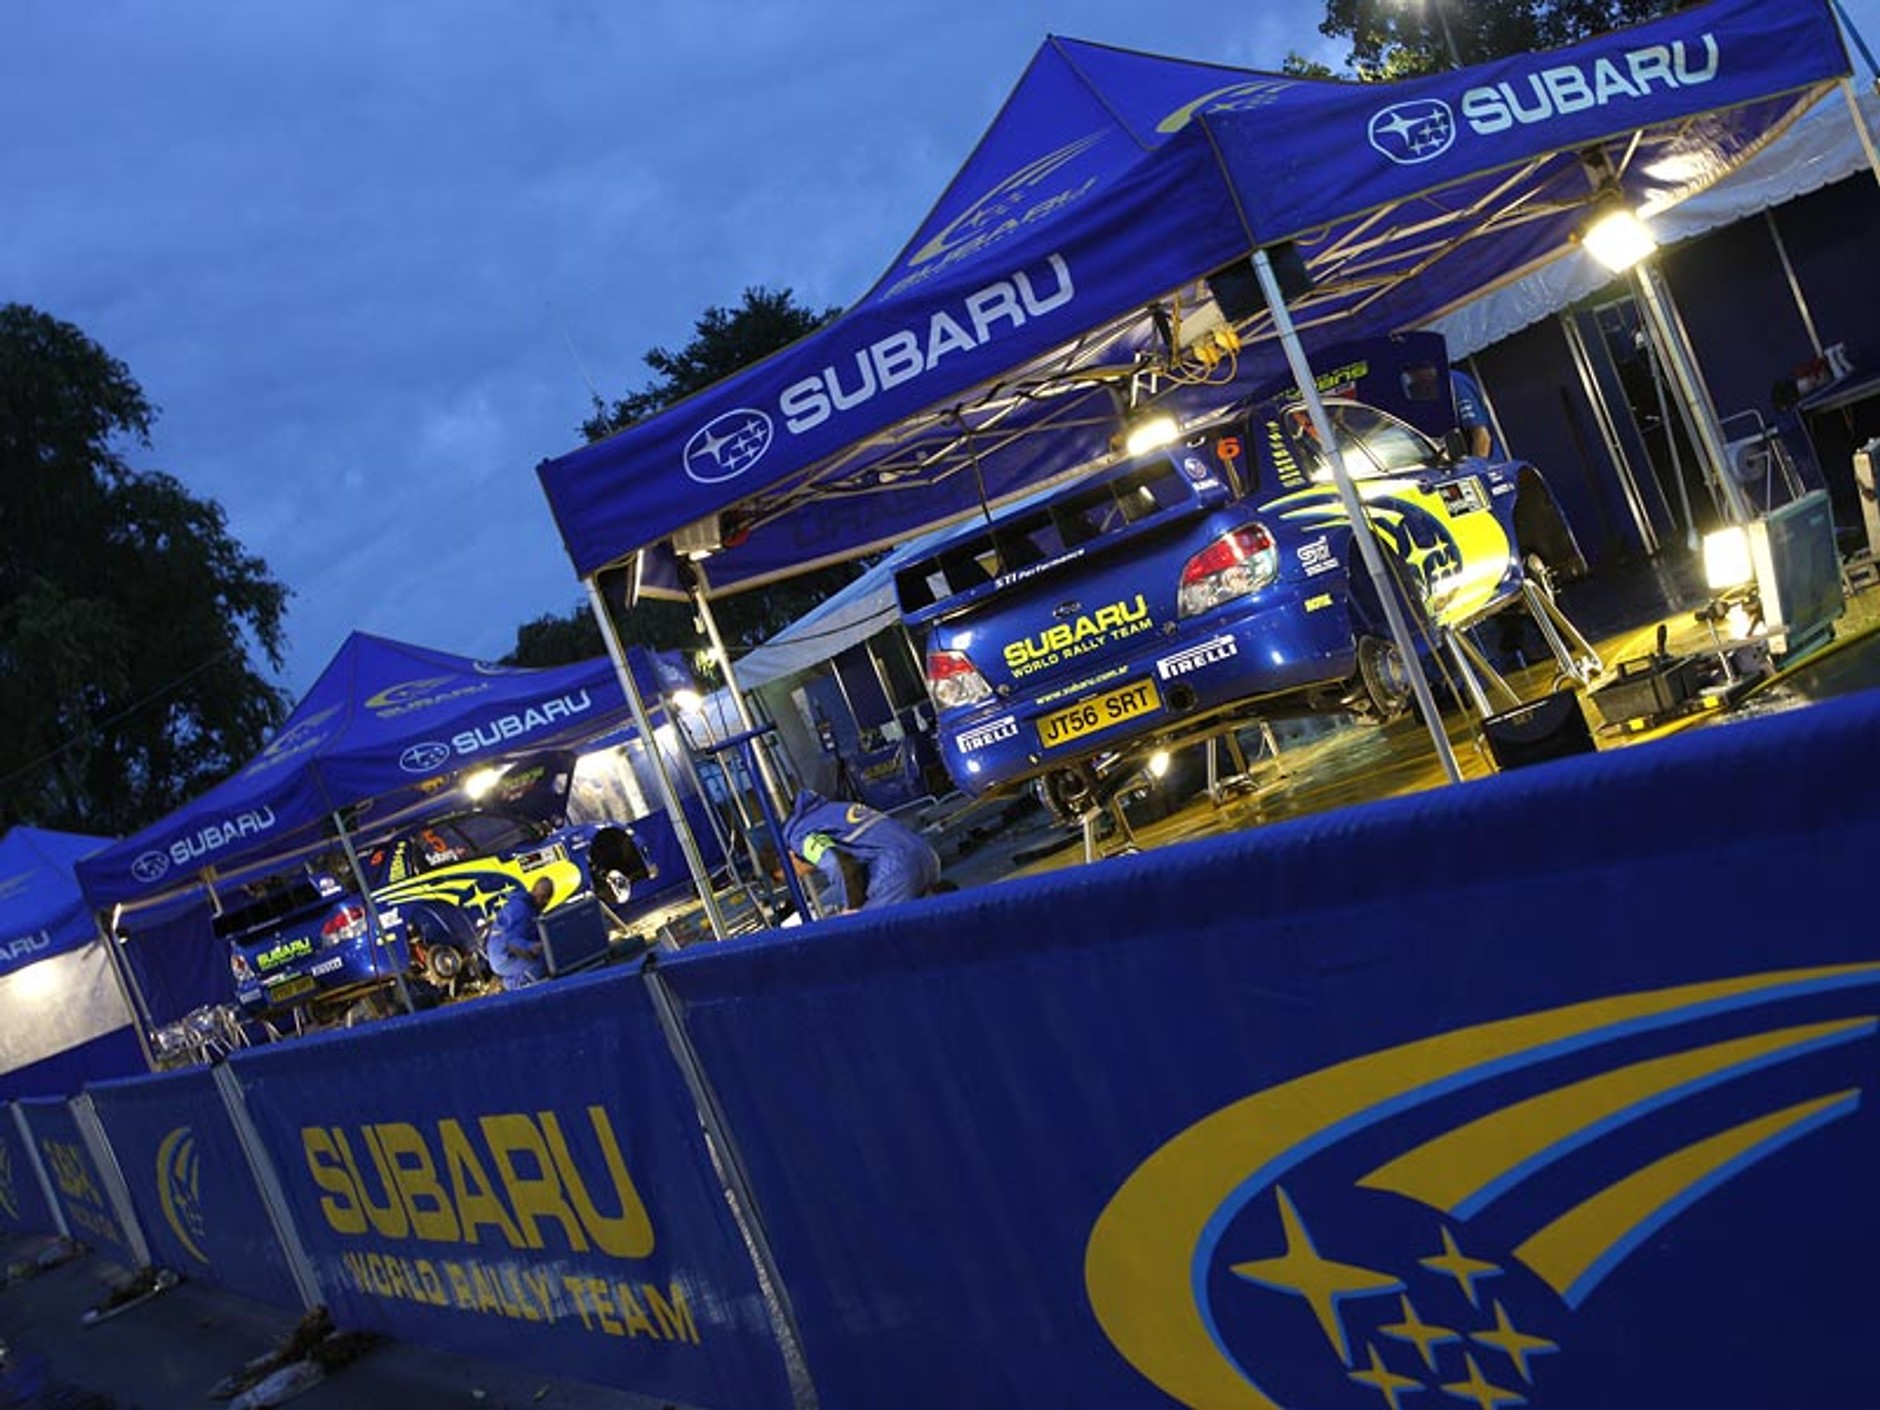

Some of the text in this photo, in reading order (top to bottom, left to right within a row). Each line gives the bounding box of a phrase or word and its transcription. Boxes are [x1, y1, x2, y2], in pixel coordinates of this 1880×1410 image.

[1461, 32, 1720, 136] SUBARU
[779, 252, 1075, 438] SUBARU
[1217, 437, 1240, 461] 6
[994, 572, 1017, 590] STI
[1003, 593, 1148, 668] SUBARU
[1011, 618, 1153, 680] WORLD RALLY TEAM
[1157, 634, 1238, 681] PIRELLI
[452, 689, 592, 755] SUBARU
[956, 717, 1019, 754] PIRELLI
[1045, 685, 1152, 742] JT56 SRT
[169, 805, 277, 866] SUBARU
[301, 1106, 657, 1260] SUBARU
[345, 1253, 702, 1346] WORLD RALLY TEAM
